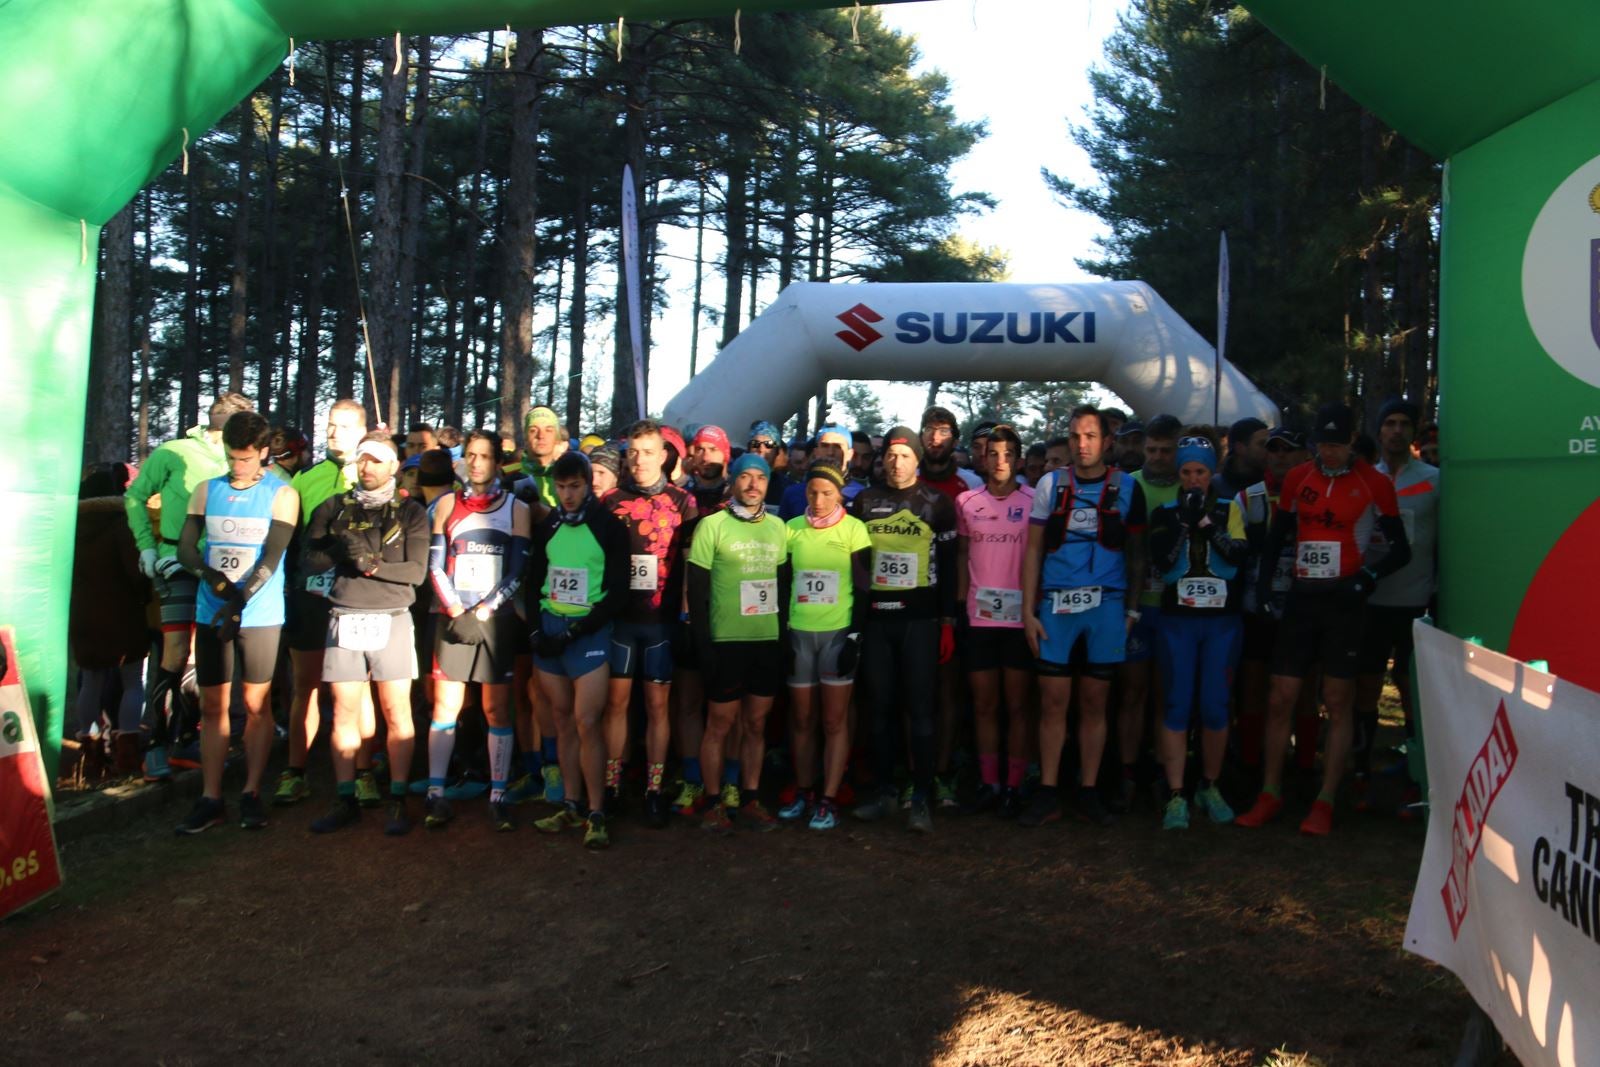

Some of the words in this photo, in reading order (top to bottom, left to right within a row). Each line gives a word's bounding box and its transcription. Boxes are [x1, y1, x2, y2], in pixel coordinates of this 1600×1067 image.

[895, 311, 1096, 344] SUZUKI
[1569, 439, 1597, 454] DE
[220, 557, 239, 569] 20
[1301, 552, 1330, 565] 485
[880, 561, 908, 575] 363
[552, 578, 578, 591] 142
[806, 581, 825, 592] 10
[1187, 584, 1217, 596] 259
[759, 590, 767, 602] 9
[1062, 593, 1093, 606] 463
[993, 599, 1003, 610] 3
